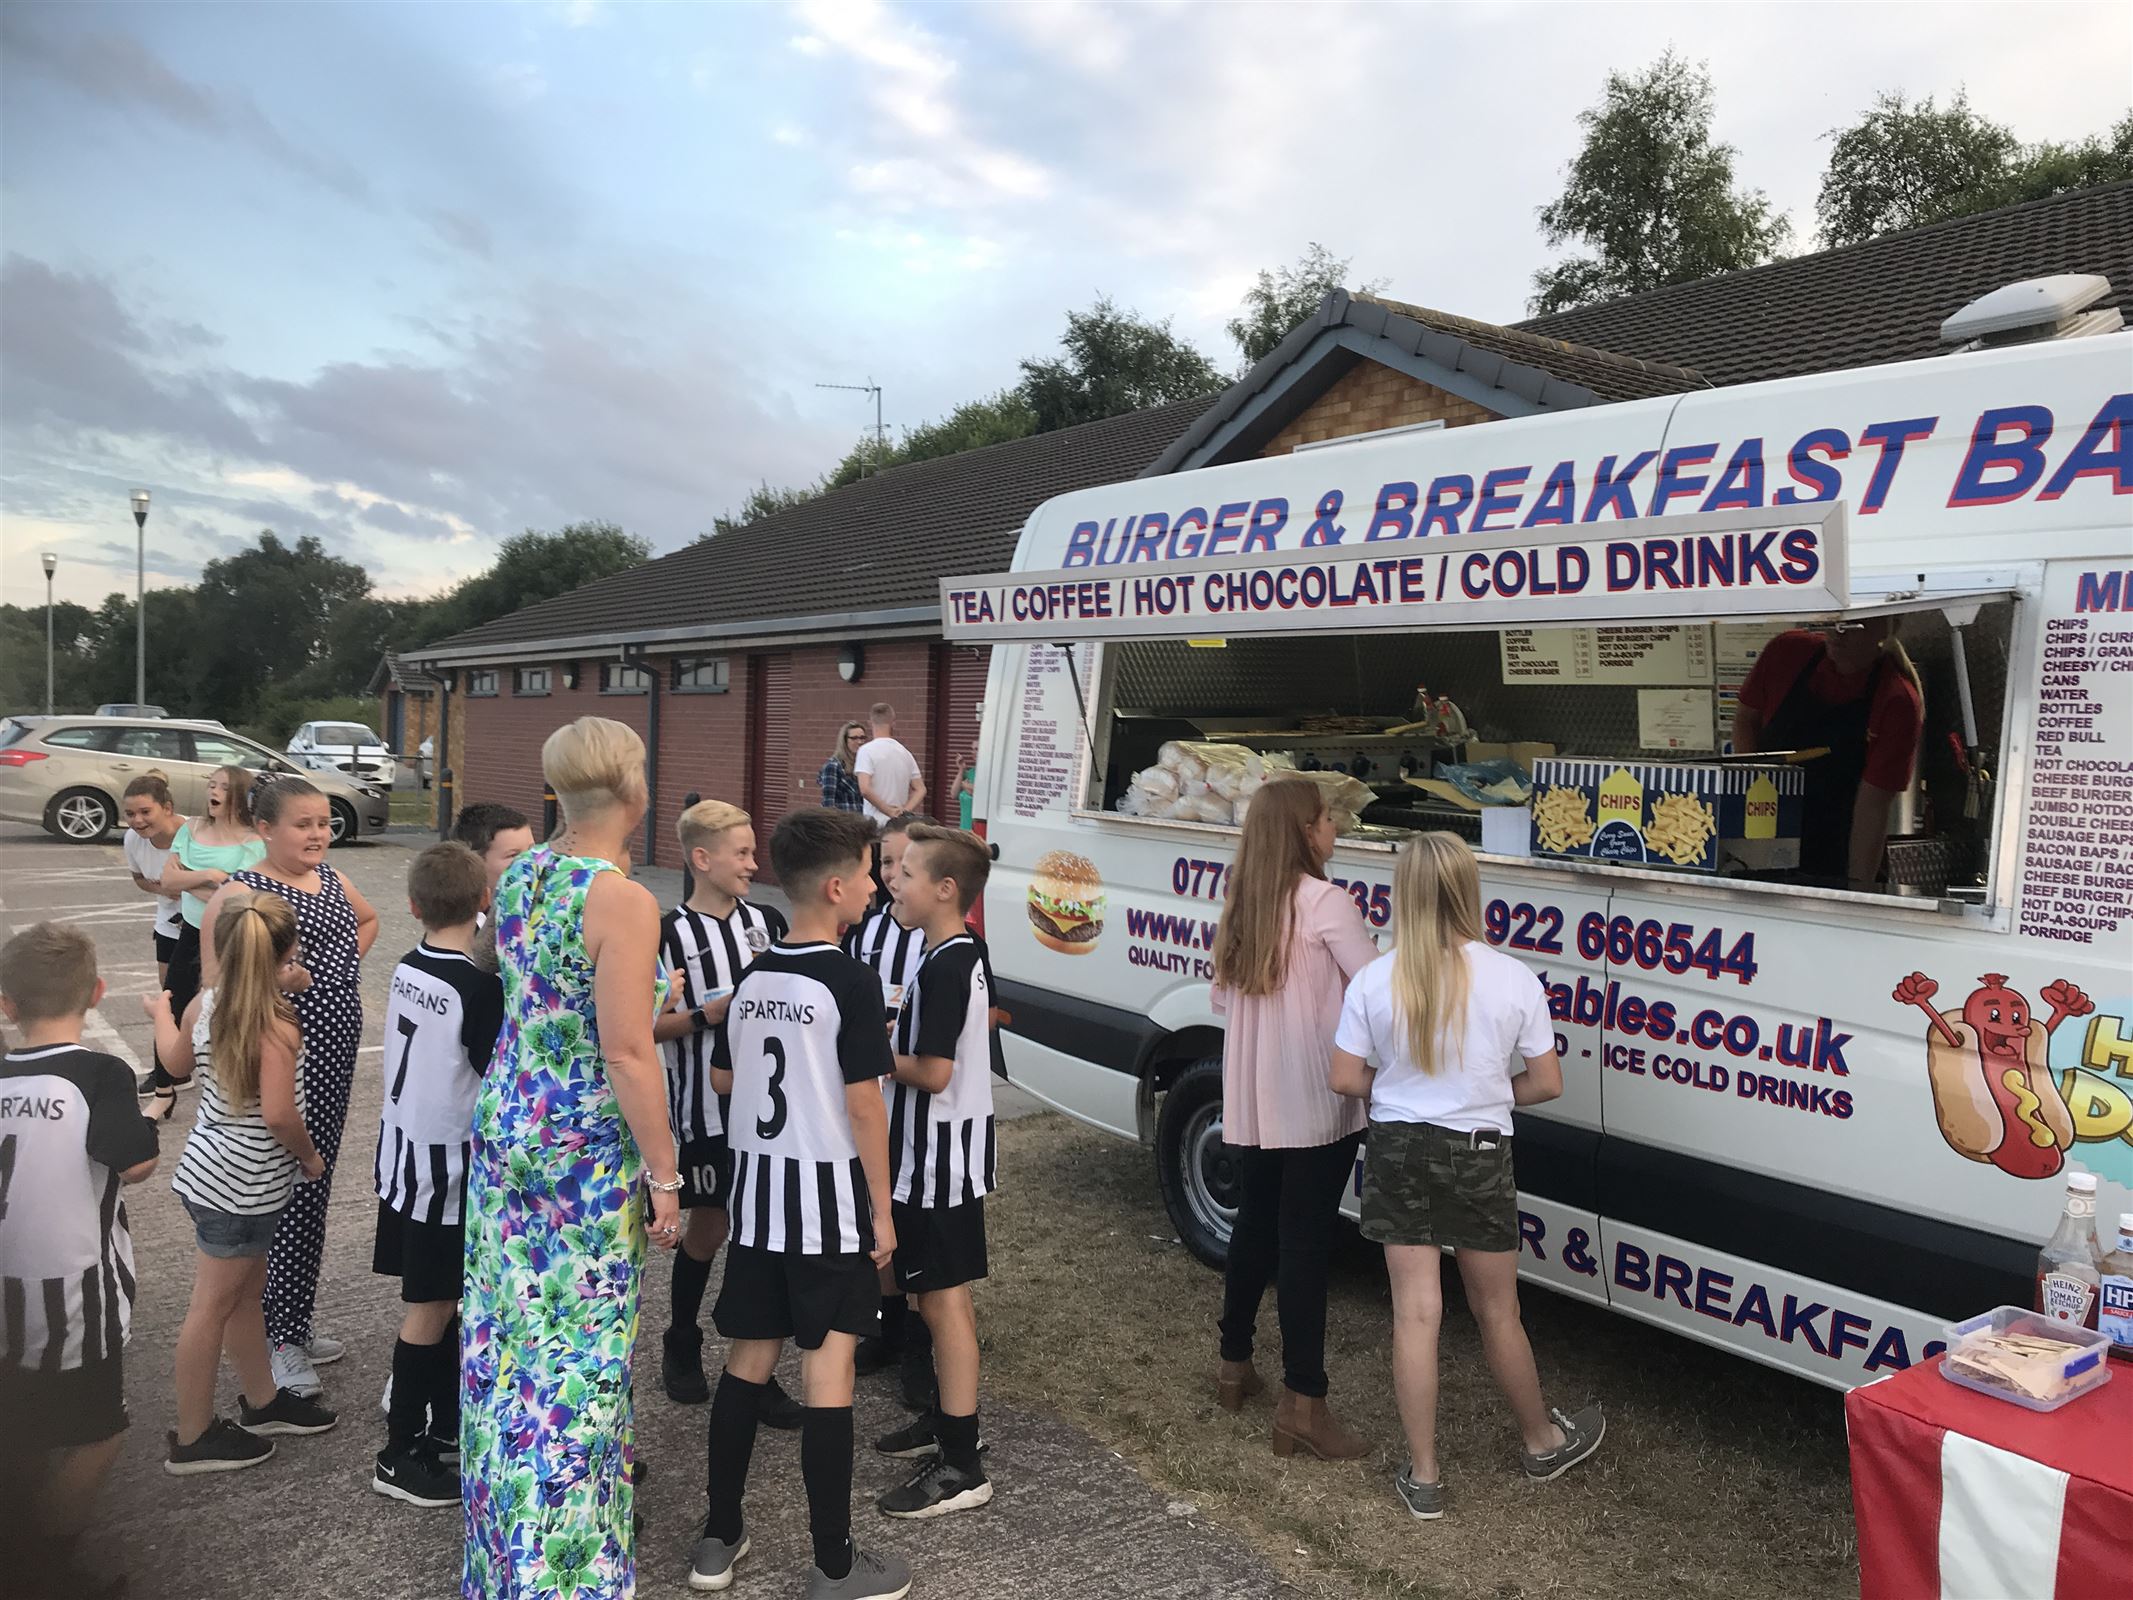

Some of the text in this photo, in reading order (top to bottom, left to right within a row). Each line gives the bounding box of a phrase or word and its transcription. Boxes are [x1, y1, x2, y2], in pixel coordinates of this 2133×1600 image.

[1062, 498, 1290, 568] BURGER
[1301, 490, 1346, 548] &
[1365, 416, 1940, 542] BREAKFAST
[950, 528, 1820, 623] TEA / COFFEE / HOT CHOCOLATE / COLD DRINKS
[2047, 619, 2089, 630] CHIPS
[2045, 633, 2087, 644] CHIPS
[2044, 647, 2086, 658] CHIPS
[2043, 660, 2099, 672] CHEESY
[2041, 675, 2080, 686] CANS
[2040, 689, 2088, 700] WATER
[2039, 703, 2103, 714] BOTTLES
[2037, 717, 2093, 728] COFFEE
[2036, 731, 2105, 743] RED BULL
[2035, 745, 2062, 756] TEA
[2034, 758, 2063, 770] HOT
[2033, 773, 2088, 785] CHEESE
[2031, 786, 2132, 802] BEEF BURGER
[1600, 794, 1640, 811] CHIPS
[1747, 801, 1776, 816] CHIPS
[2030, 801, 2079, 813] JUMBO
[2029, 815, 2086, 828] DOUBLE
[2027, 828, 2095, 843] SAUSAGE
[2026, 842, 2076, 856] BACON
[2080, 846, 2119, 860] BAPS
[2025, 857, 2093, 872] SAUSAGE
[2024, 870, 2080, 885] CHEESE
[2023, 884, 2059, 897] BEEF
[2063, 888, 2124, 904] BURGER
[2022, 898, 2051, 910] HOT
[2054, 901, 2085, 914] DOG
[2020, 911, 2117, 932] CUP-A-SOUPS
[2019, 924, 2093, 944] PORRIDGE
[1485, 899, 1564, 954] 922
[1577, 911, 1758, 985] 666544
[1128, 946, 1191, 976] QUALITY
[1604, 1042, 1646, 1075] ICE
[1652, 1053, 1729, 1092] COLD
[1737, 1071, 1854, 1119] DRINKS
[391, 1013, 419, 1106] 7
[756, 1036, 787, 1140] 3
[692, 1164, 717, 1195] 10
[1562, 1227, 1598, 1278] &
[2053, 1280, 2081, 1294] HEINZ
[2050, 1290, 2083, 1304] TOMATO
[2051, 1298, 2081, 1310] KETCHUP
